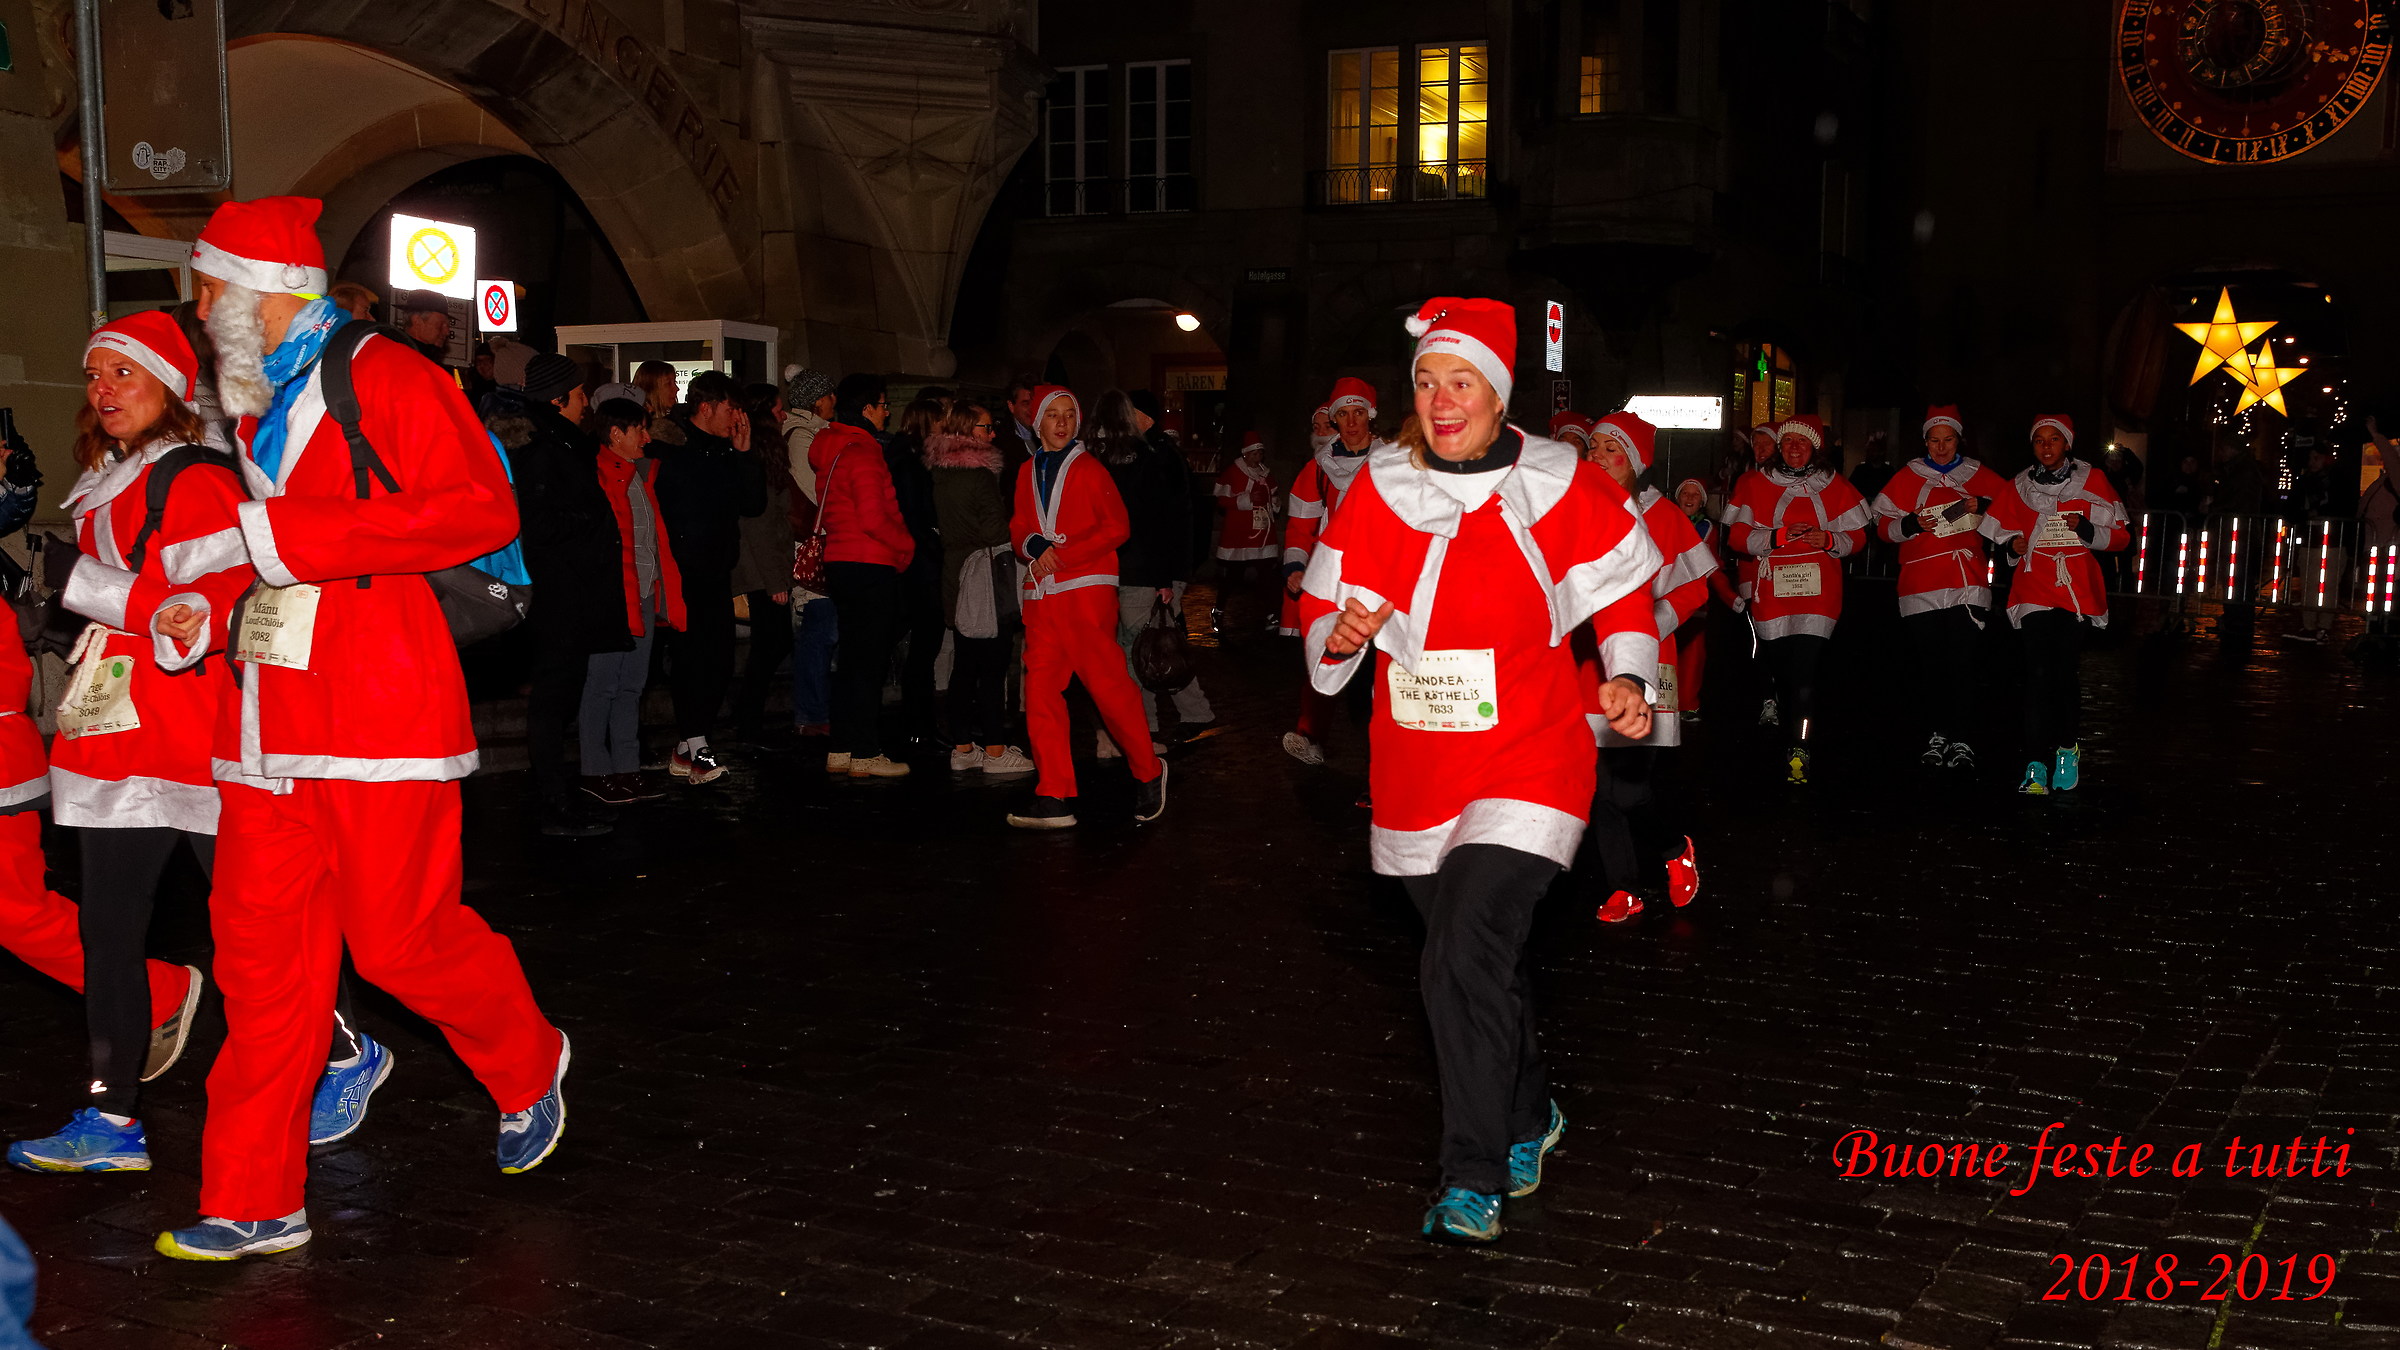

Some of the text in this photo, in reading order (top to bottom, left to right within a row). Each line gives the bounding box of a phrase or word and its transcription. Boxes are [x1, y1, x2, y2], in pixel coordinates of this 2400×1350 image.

[1176, 372, 1215, 390] BÄREN
[252, 603, 279, 616] Mänu
[250, 630, 271, 642] 3082
[1414, 676, 1464, 686] ANDREA
[1658, 677, 1673, 691] kie
[88, 682, 104, 694] rige
[1400, 690, 1420, 700] THE
[79, 706, 100, 718] 3049
[1428, 704, 1454, 714] 7633
